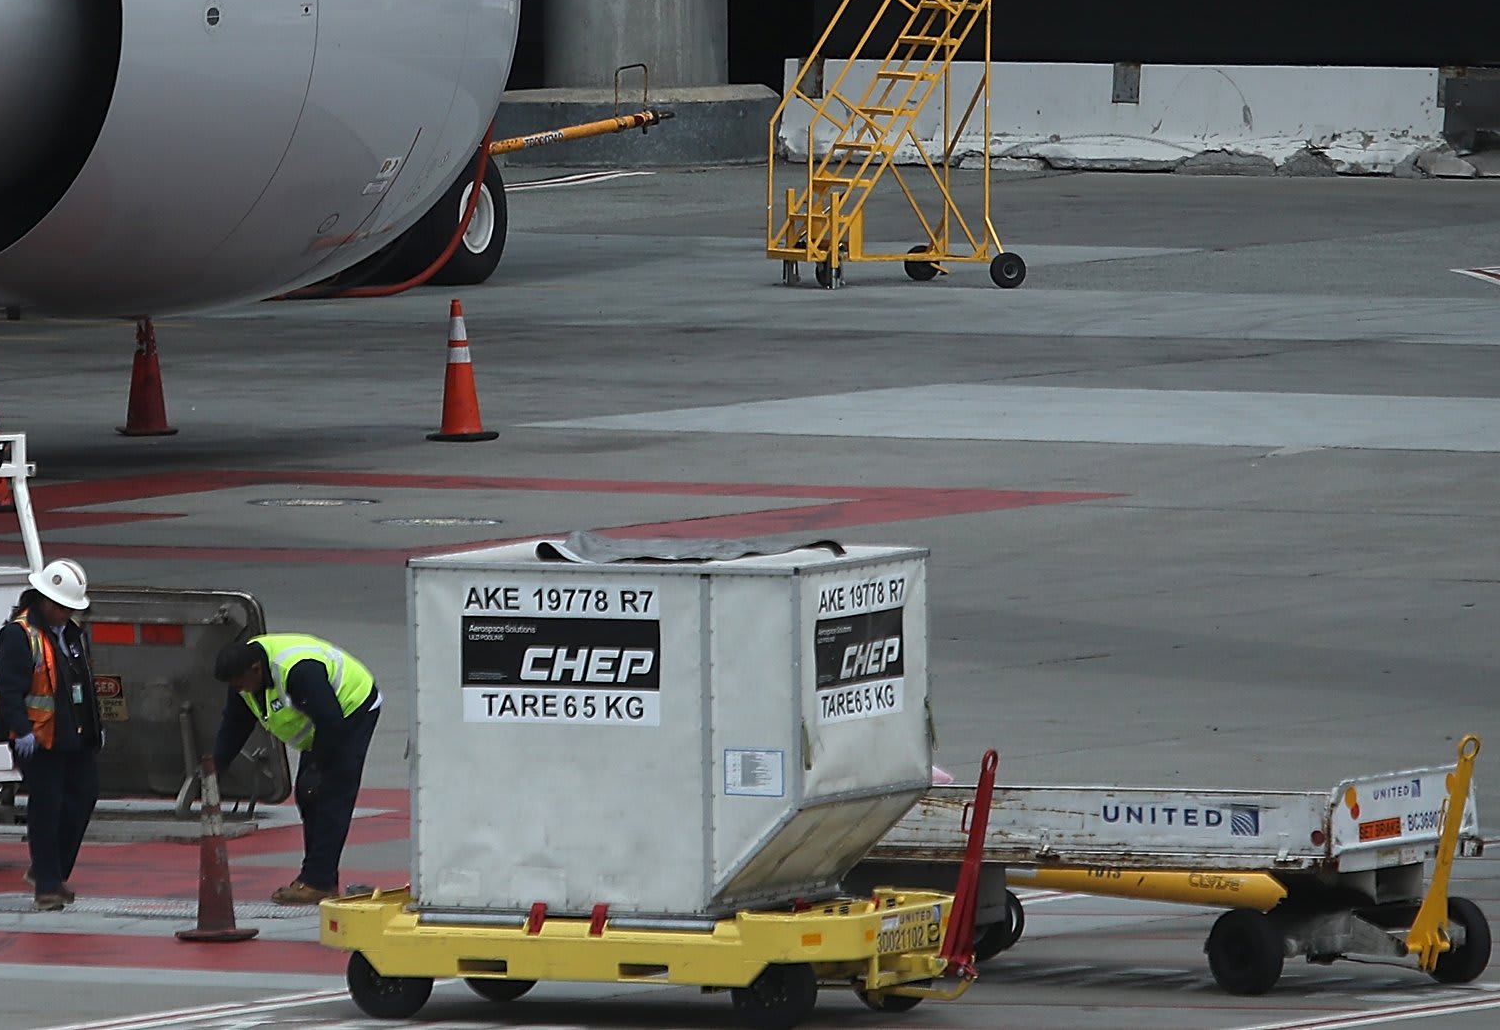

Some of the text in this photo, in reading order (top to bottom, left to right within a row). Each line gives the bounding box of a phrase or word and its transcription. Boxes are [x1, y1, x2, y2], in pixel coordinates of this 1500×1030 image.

[464, 586, 653, 613] AKE 19778 R7
[818, 578, 905, 613] AKE 19778 R7
[468, 624, 536, 634] Aerospace Solutions
[519, 646, 655, 683] CHEP
[840, 637, 900, 680] CHEP
[95, 681, 115, 693] GER
[875, 684, 895, 710] KG
[481, 693, 558, 717] TARE
[605, 696, 644, 720] KG
[1373, 785, 1410, 801] UNITED
[1102, 805, 1223, 828] UNITED
[1359, 825, 1373, 840] SET
[899, 910, 932, 924] UNITED
